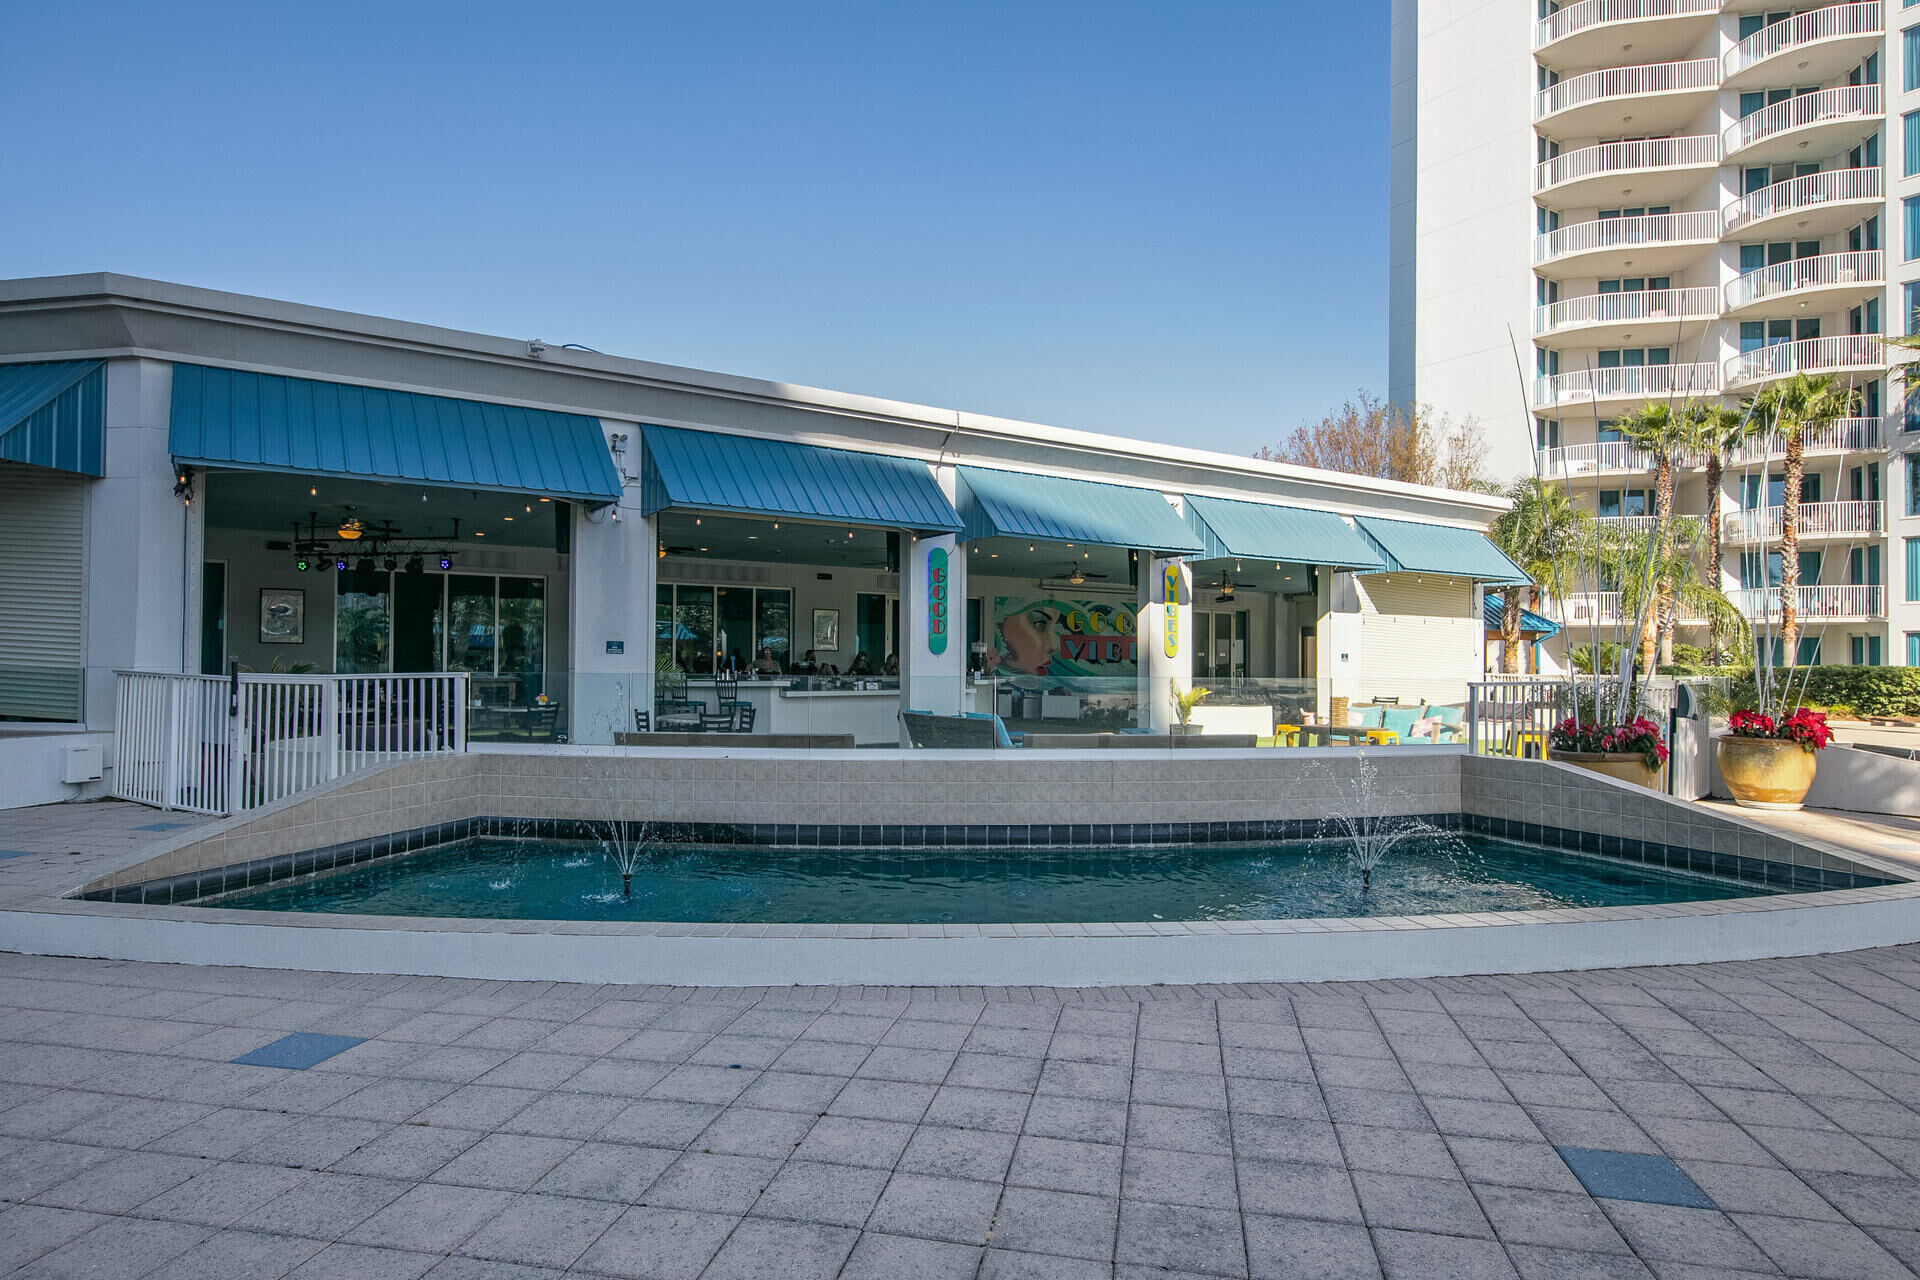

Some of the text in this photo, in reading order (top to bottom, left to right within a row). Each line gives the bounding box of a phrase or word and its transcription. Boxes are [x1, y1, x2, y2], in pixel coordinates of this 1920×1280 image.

[932, 567, 946, 635] GOOD
[1066, 610, 1134, 634] GOO
[1166, 575, 1177, 648] VIBES
